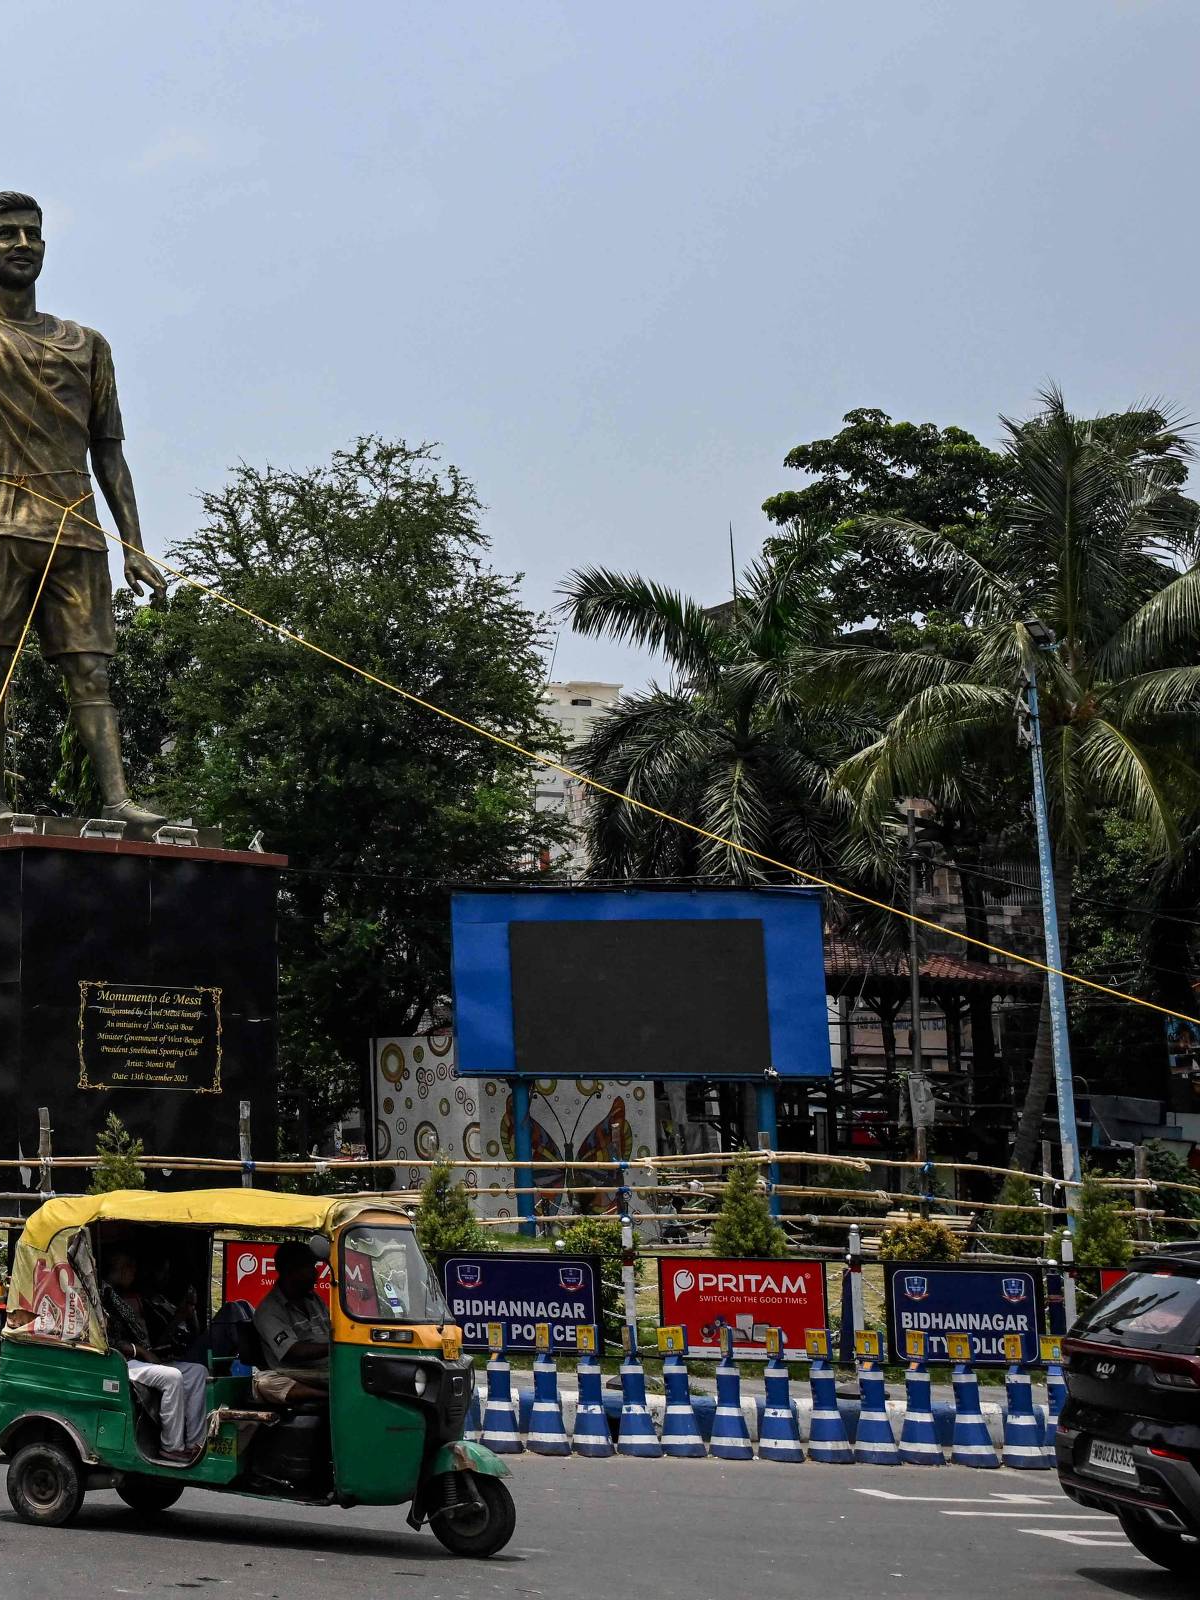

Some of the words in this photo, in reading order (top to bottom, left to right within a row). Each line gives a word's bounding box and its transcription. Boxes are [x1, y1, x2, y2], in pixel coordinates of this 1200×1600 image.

[96, 990, 157, 1003] Monumento
[159, 992, 171, 1003] de
[172, 994, 203, 1006] Messi
[104, 1020, 115, 1029] An
[142, 1020, 150, 1031] of
[151, 1022, 164, 1030] Shri
[96, 1032, 123, 1040] Minister
[123, 1033, 158, 1043] Government
[159, 1034, 168, 1044] of
[168, 1034, 183, 1043] West
[183, 1036, 205, 1046] Bengal
[100, 1046, 128, 1054] President
[158, 1047, 184, 1058] Sporting
[184, 1048, 199, 1056] Club
[165, 1060, 177, 1069] Pal
[130, 1073, 145, 1081] 13th
[145, 1073, 173, 1081] December
[173, 1074, 189, 1082] 2025
[699, 1273, 807, 1294] PRITAM
[729, 1295, 742, 1303] ON
[744, 1296, 757, 1304] THE
[759, 1296, 782, 1304] GOOD
[784, 1297, 808, 1305] TIMES
[453, 1299, 586, 1319] BIDHANNAGAR
[901, 1311, 1029, 1331] BIDHANNAGAR
[464, 1322, 489, 1339] CIT
[511, 1323, 577, 1342] POCE
[929, 1336, 949, 1353] TY
[972, 1337, 1006, 1354] OLIC
